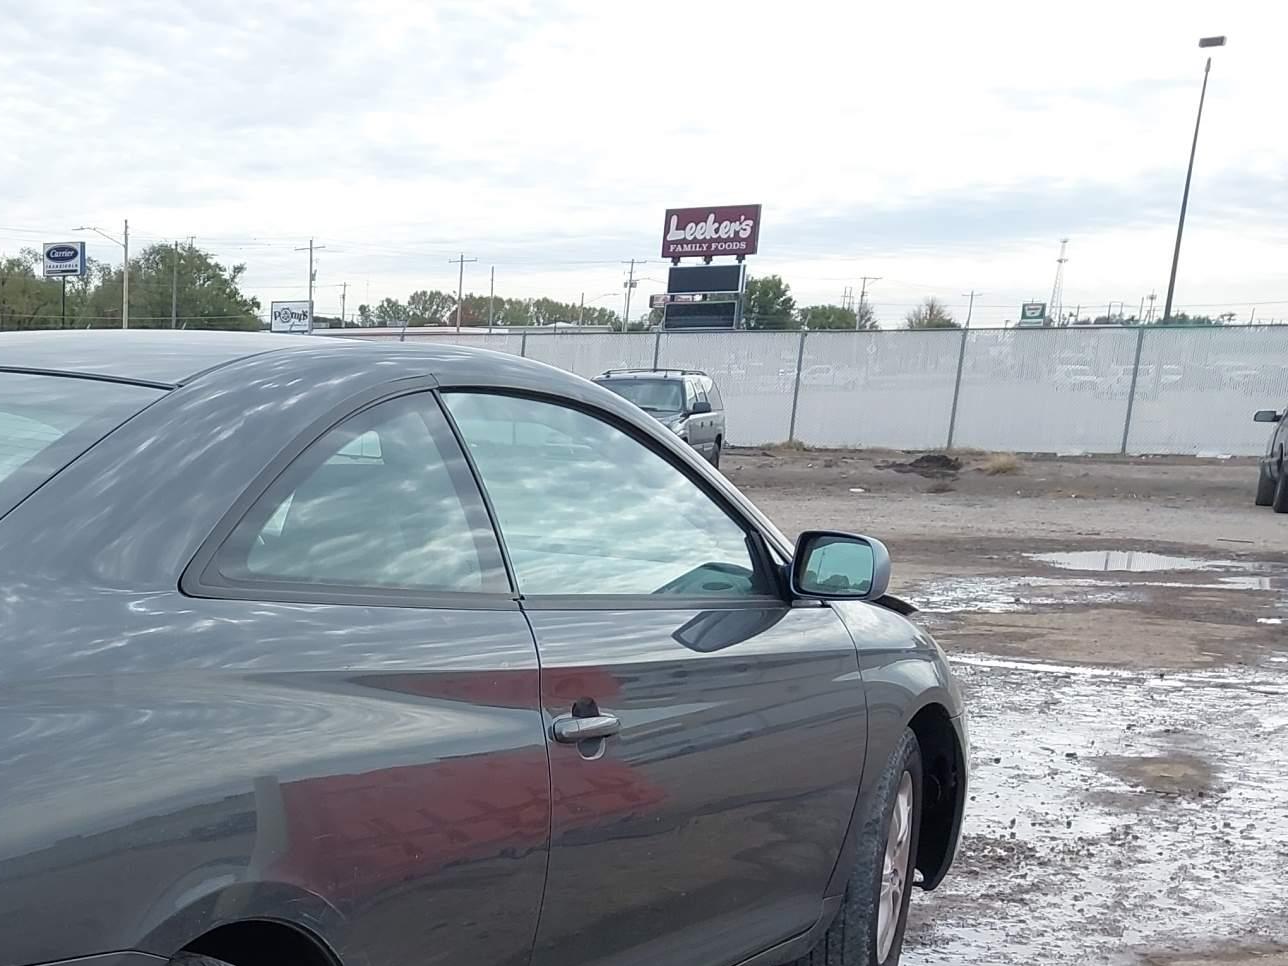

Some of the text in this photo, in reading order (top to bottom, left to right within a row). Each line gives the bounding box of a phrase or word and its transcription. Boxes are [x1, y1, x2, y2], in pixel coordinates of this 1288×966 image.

[667, 212, 754, 241] Leeker's
[669, 241, 747, 252] FAMILY FOODS
[49, 248, 75, 258] Carrier
